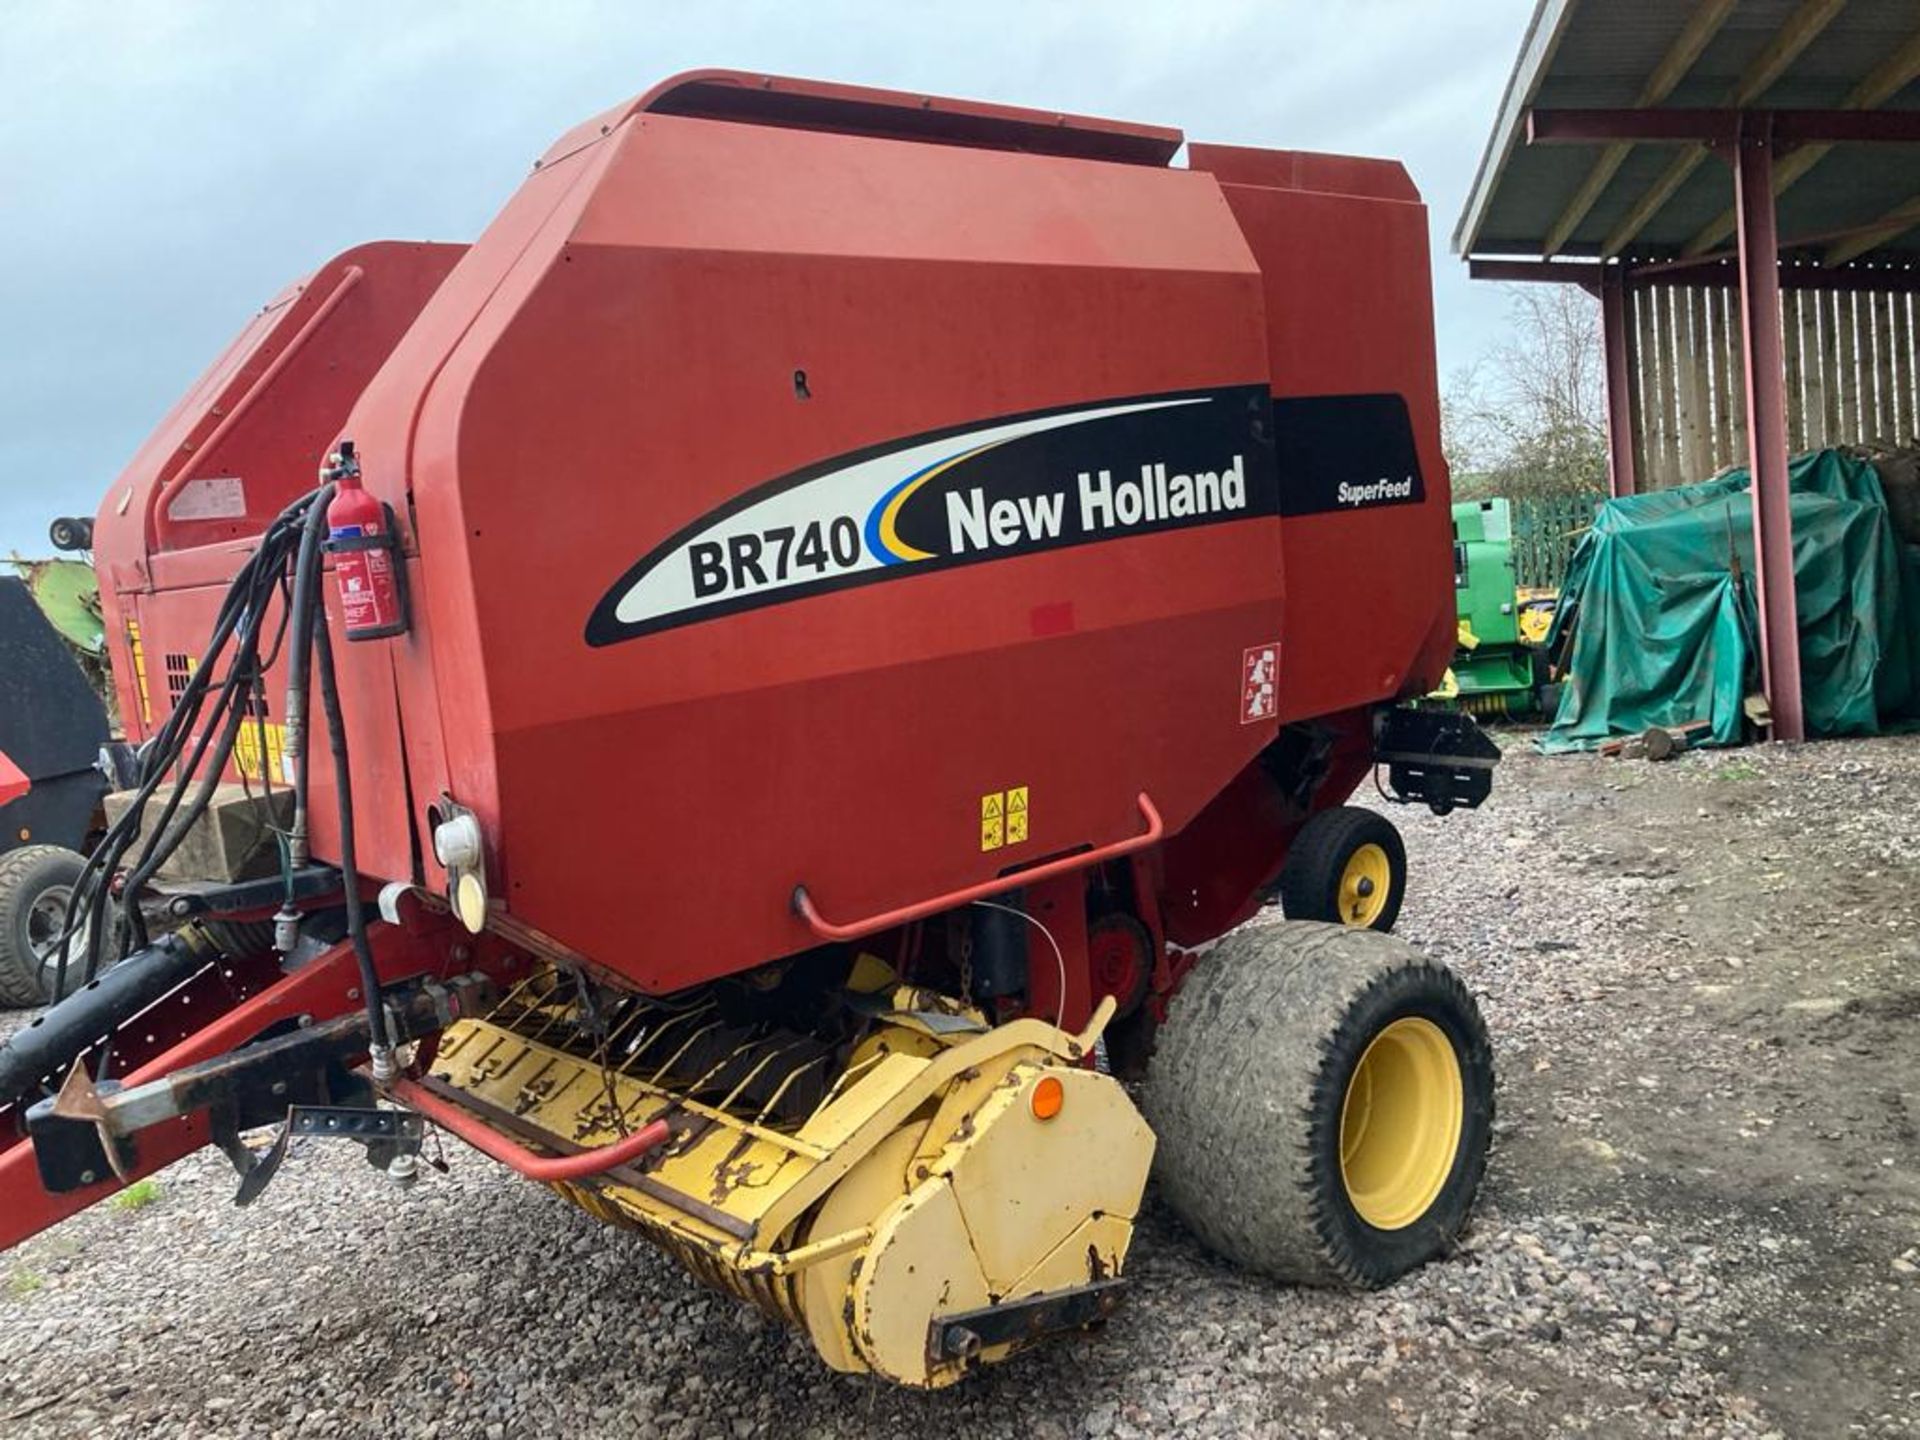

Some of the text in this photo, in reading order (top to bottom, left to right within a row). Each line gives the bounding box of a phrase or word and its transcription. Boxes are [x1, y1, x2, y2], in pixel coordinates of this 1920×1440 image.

[945, 454, 1246, 554] New Holland
[1337, 475, 1412, 507] SuperFeed
[688, 516, 860, 599] BR740
